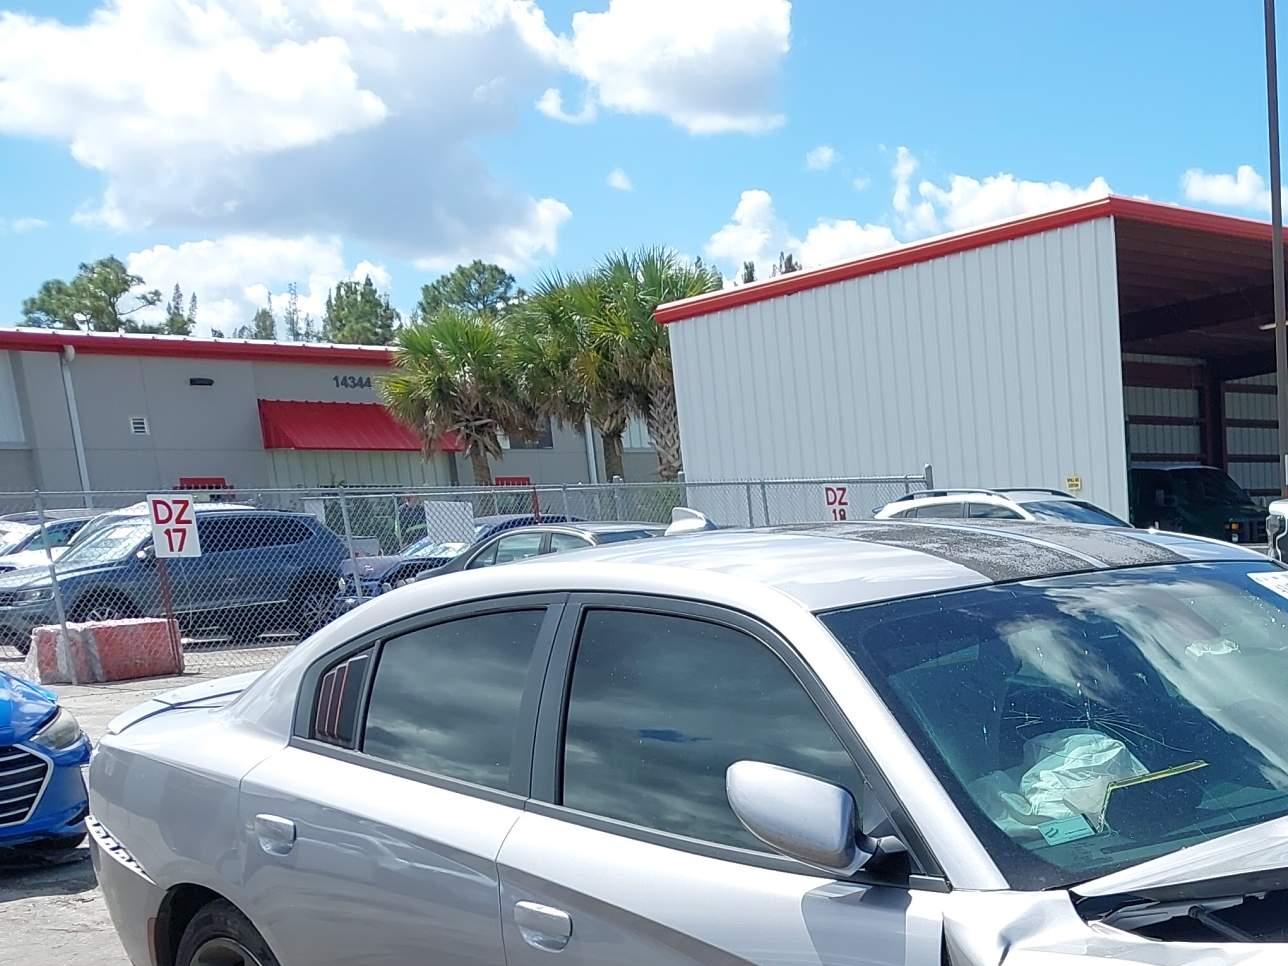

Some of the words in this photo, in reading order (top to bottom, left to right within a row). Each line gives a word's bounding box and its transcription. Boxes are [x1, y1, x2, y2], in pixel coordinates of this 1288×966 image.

[332, 375, 372, 389] 14344
[824, 487, 849, 506] DZ
[151, 499, 193, 525] DZ
[164, 527, 187, 552] 17
